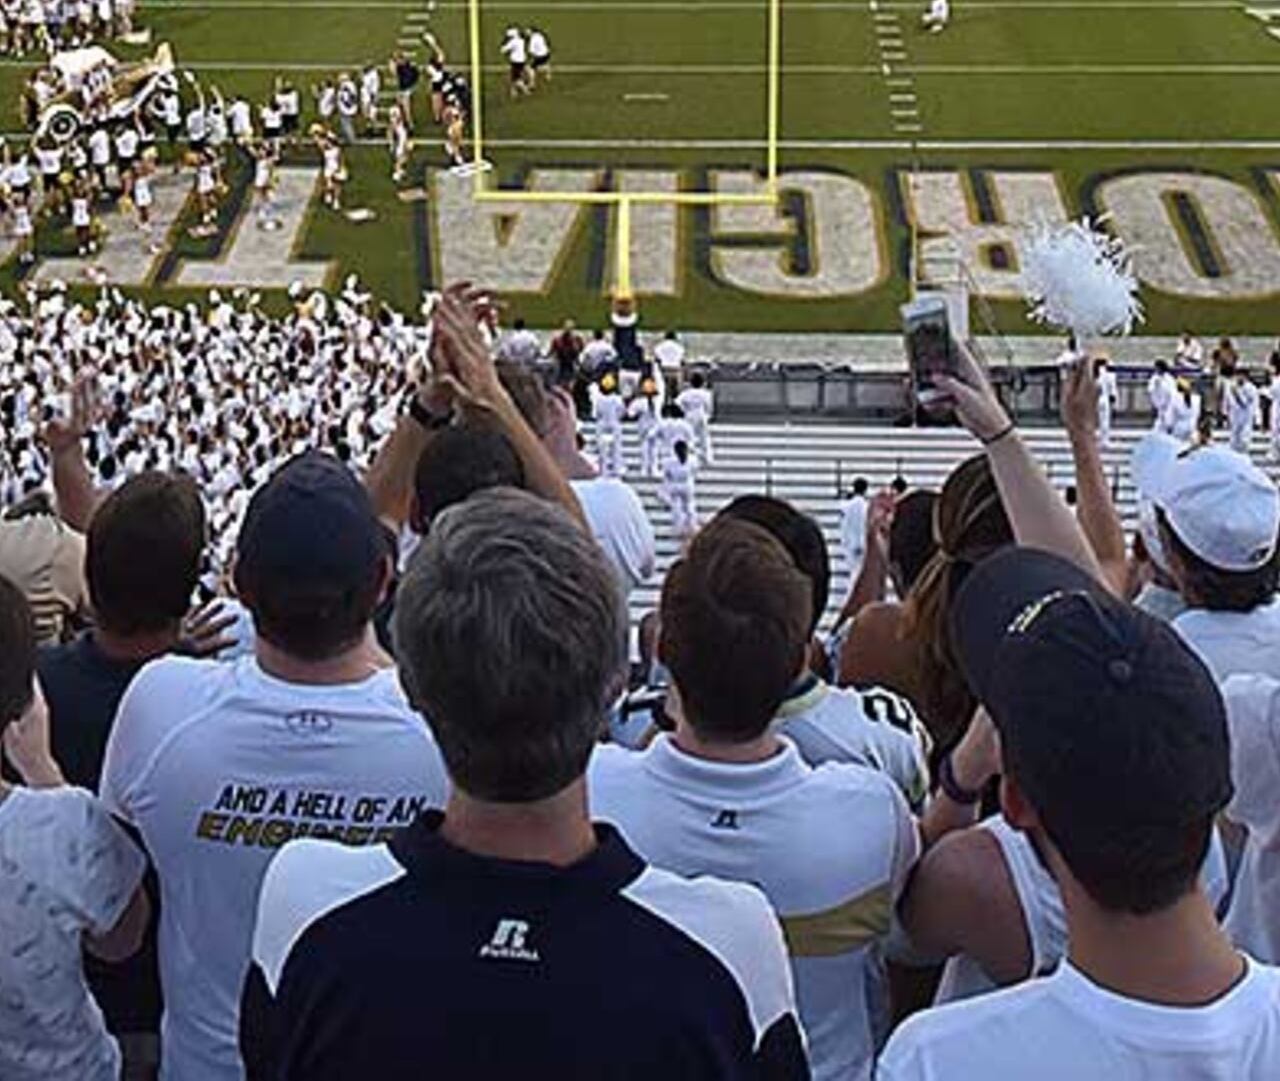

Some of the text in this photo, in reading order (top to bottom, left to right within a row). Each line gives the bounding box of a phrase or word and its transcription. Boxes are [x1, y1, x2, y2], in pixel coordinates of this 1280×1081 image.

[216, 785, 427, 823] AND A HELL OF AN
